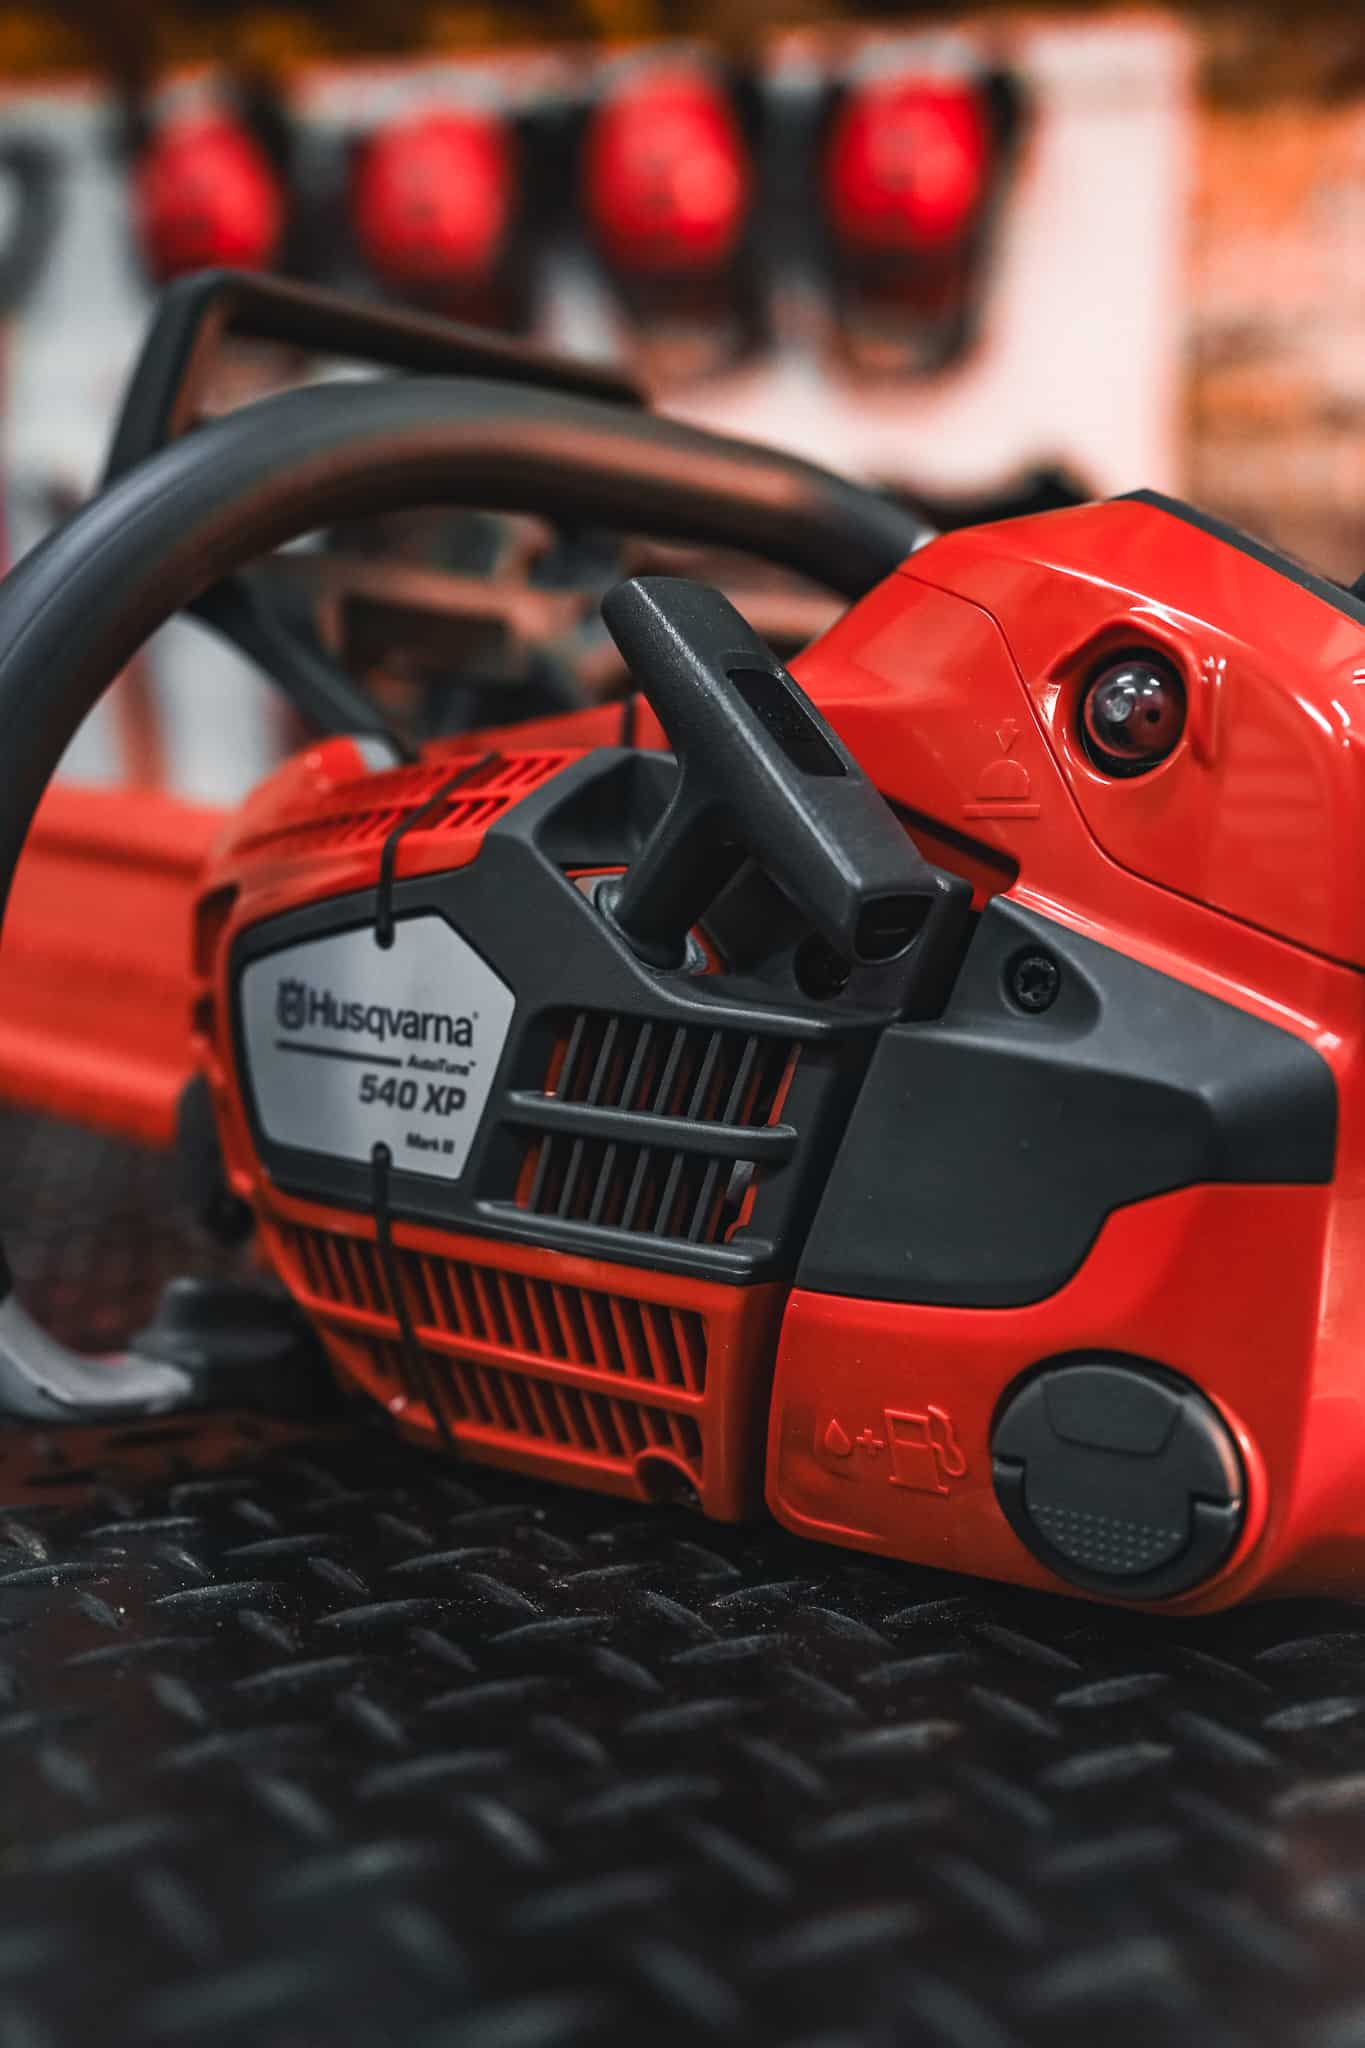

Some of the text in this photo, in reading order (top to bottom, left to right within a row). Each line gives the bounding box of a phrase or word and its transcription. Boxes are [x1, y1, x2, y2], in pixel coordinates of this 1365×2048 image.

[308, 988, 473, 1047] Husqvarna
[359, 1073, 467, 1116] 540 XP
